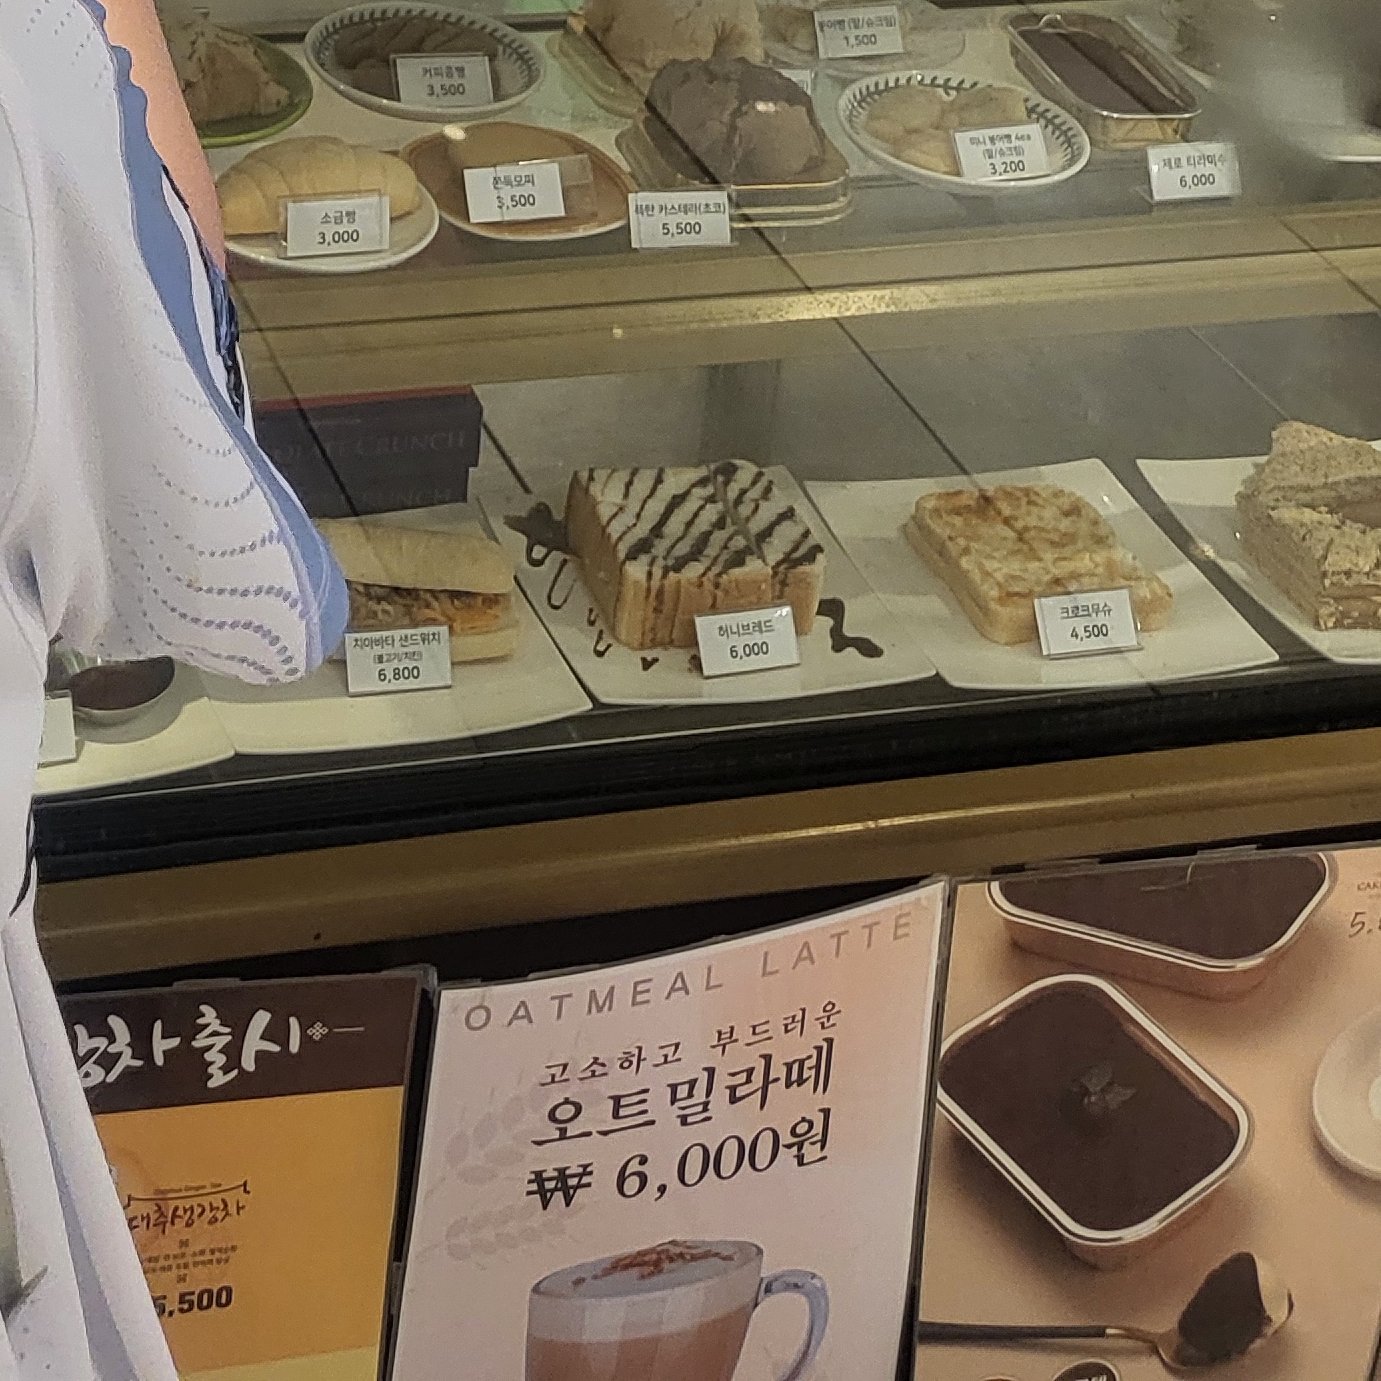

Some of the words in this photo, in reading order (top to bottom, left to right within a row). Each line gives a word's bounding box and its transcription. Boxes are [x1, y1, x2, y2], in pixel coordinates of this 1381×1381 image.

[842, 33, 878, 49] 1,500
[426, 82, 466, 98] 3,500
[988, 159, 1026, 177] 3,200
[1162, 156, 1184, 171] 제로
[1179, 172, 1216, 190] 6,000
[496, 193, 537, 210] 3,500
[319, 210, 357, 226] 소금빵
[316, 229, 360, 247] 3,000
[661, 221, 702, 238] 5,500
[1059, 601, 1113, 621] 크로크무슈
[717, 619, 776, 640] 허니브레드
[1070, 623, 1109, 642] 4,500
[353, 634, 396, 650] 치아바타
[398, 630, 442, 648] 샌드위치
[729, 640, 770, 660] 6,000
[377, 665, 421, 684] 6,800
[463, 964, 724, 1033] OATMEAL
[760, 910, 913, 977] LATTE
[191, 1003, 303, 1090] 출시
[539, 1041, 682, 1089] 고소하고
[709, 999, 843, 1058] 부드러운
[530, 1037, 835, 1148] 오트밀라떼
[614, 1107, 833, 1202] 6,000원
